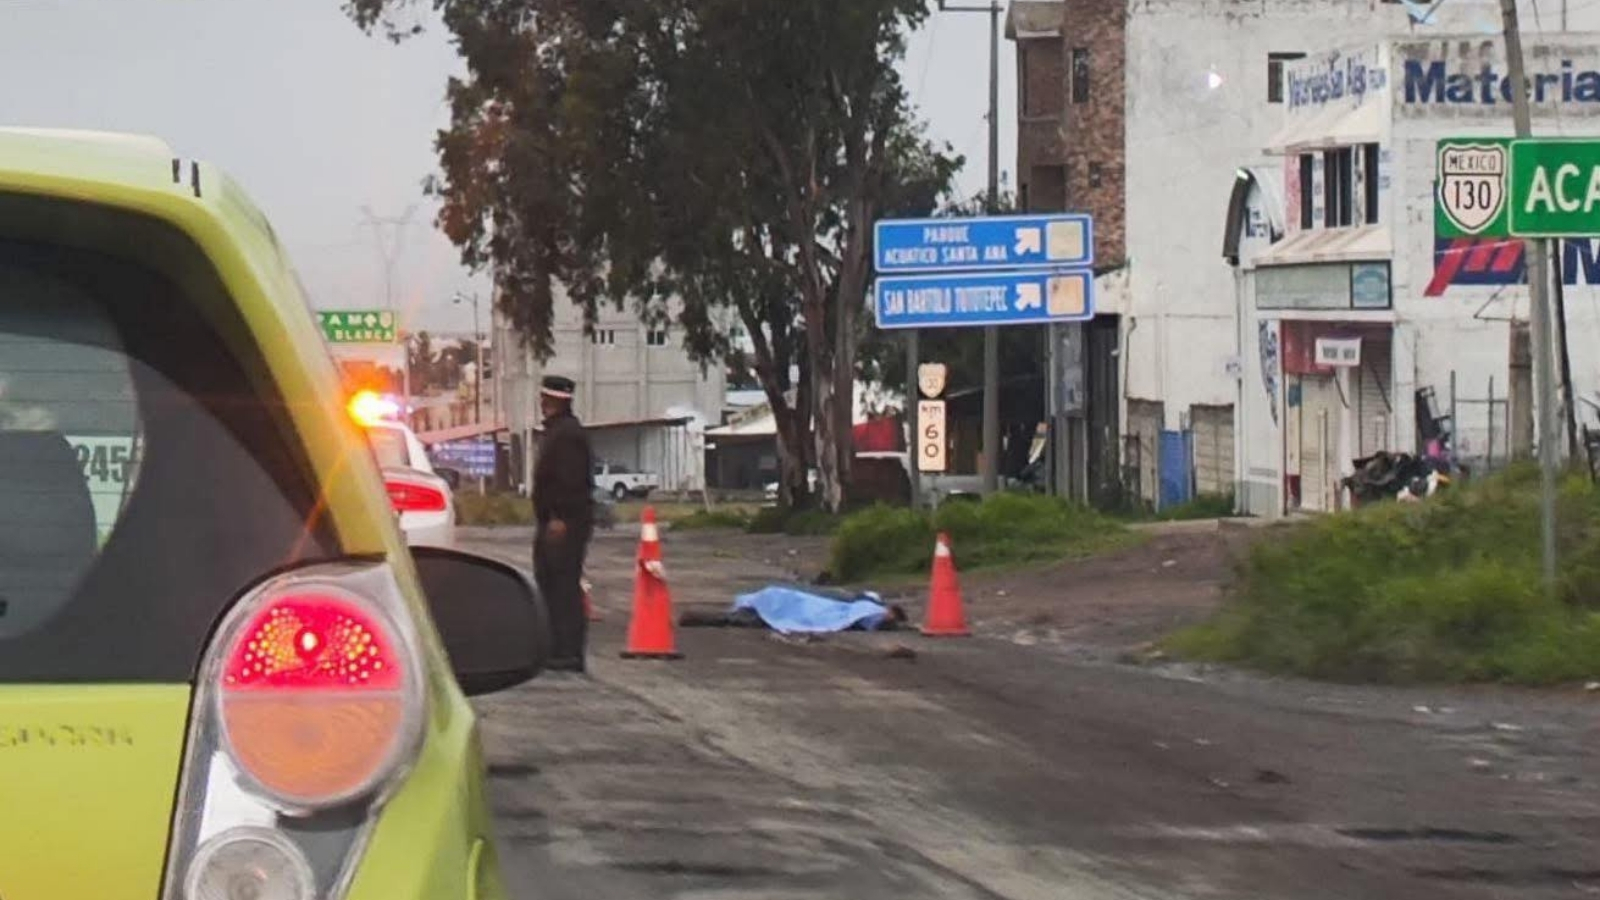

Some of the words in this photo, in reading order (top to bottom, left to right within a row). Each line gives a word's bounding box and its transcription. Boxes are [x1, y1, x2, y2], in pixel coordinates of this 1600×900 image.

[1449, 154, 1496, 172] MEXICO
[1454, 180, 1491, 210] 130
[923, 225, 969, 243] PARQUE
[941, 245, 978, 263] SANTA
[983, 245, 1007, 261] ANA
[885, 289, 904, 315] SAN
[907, 287, 951, 314] BARTOLO
